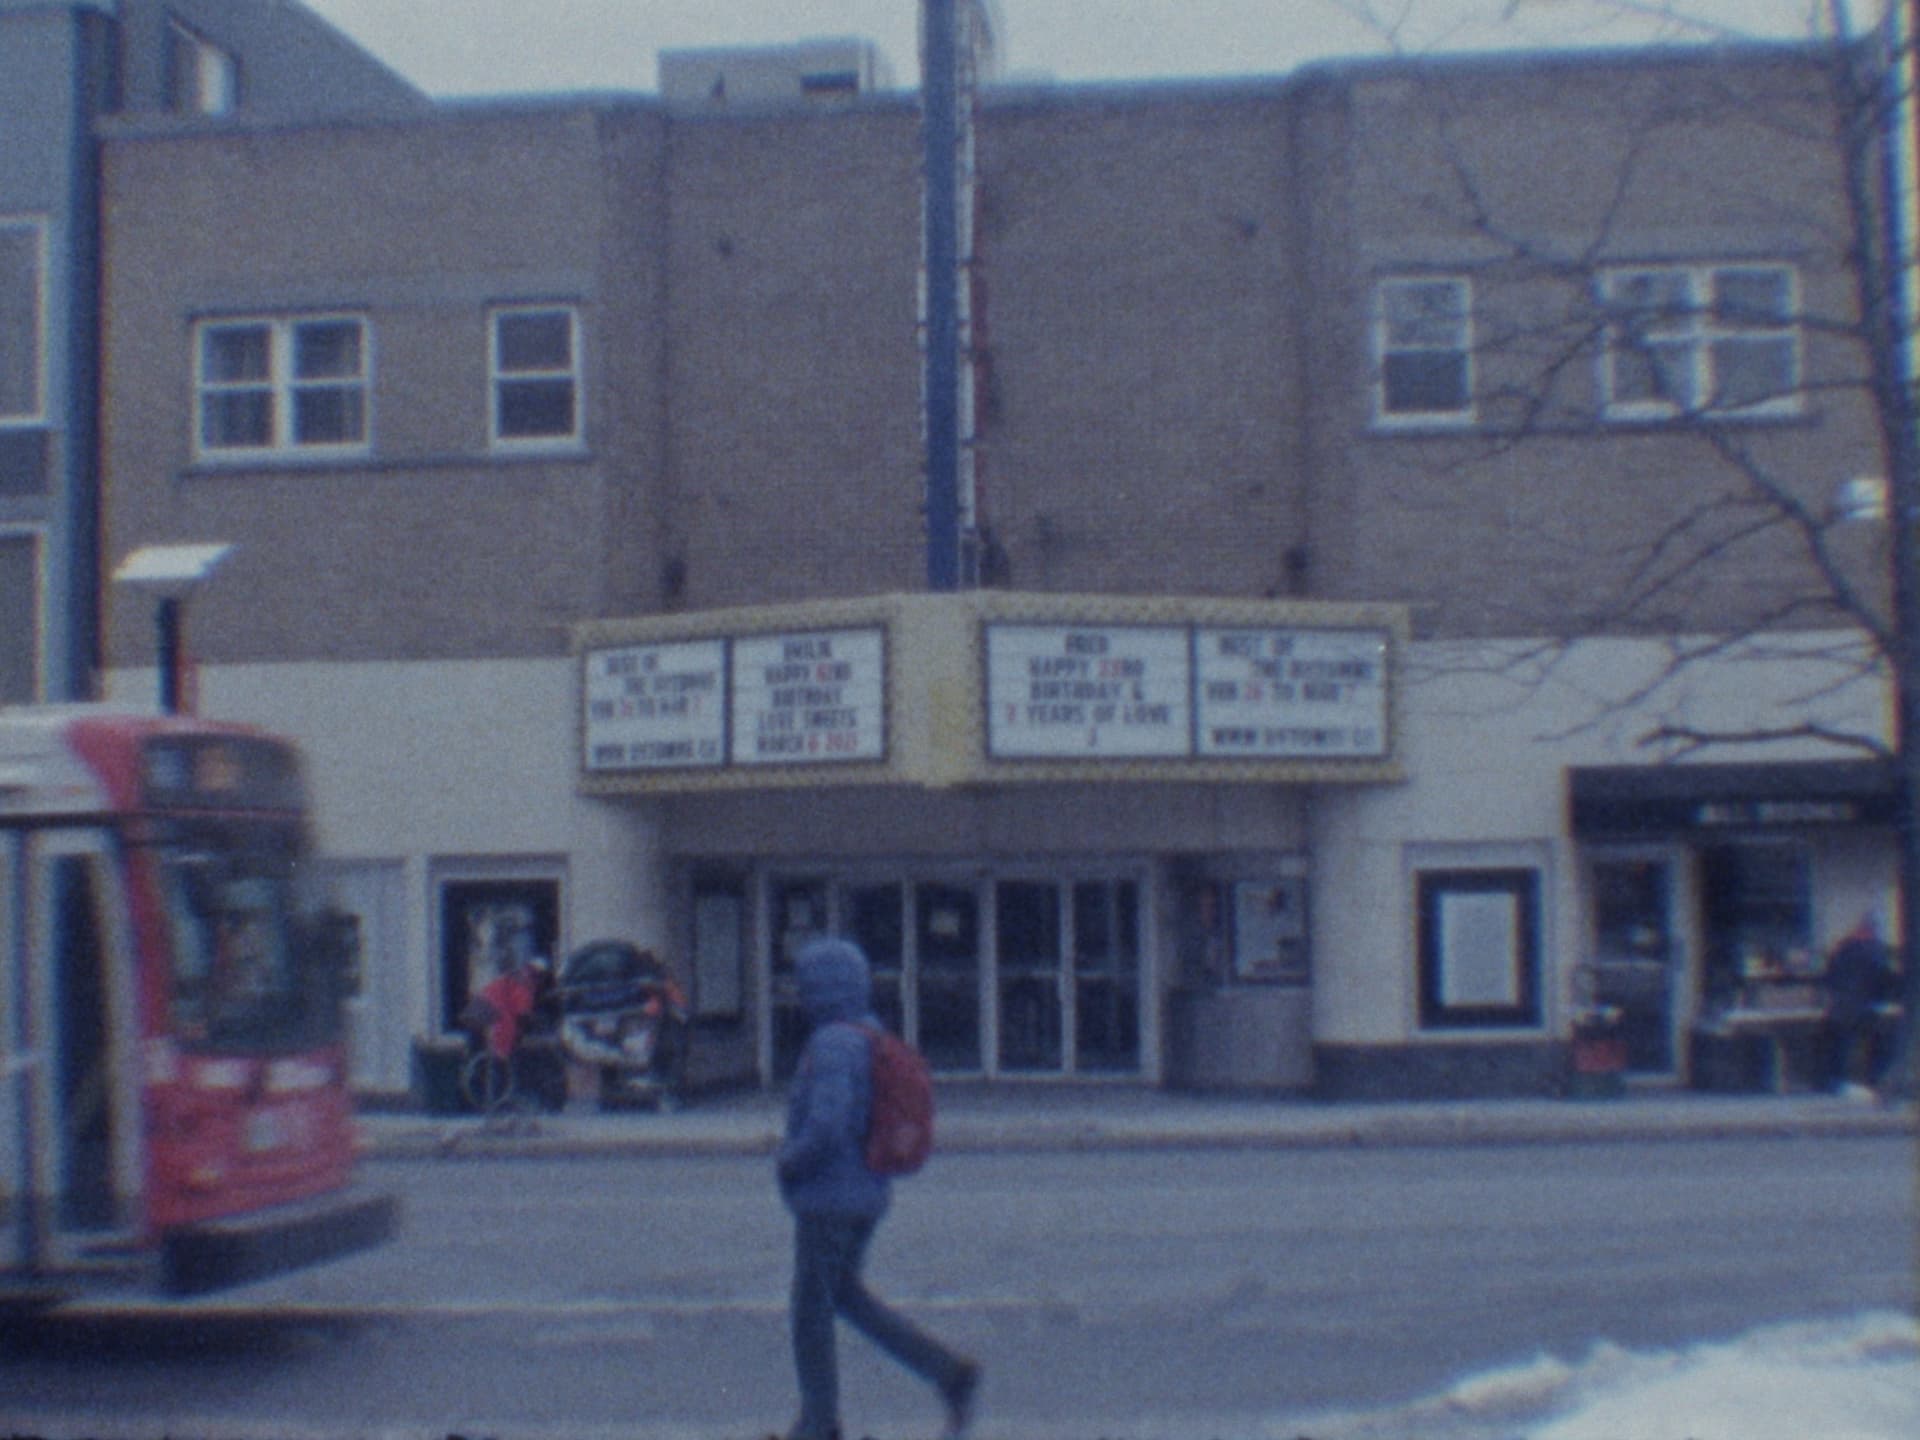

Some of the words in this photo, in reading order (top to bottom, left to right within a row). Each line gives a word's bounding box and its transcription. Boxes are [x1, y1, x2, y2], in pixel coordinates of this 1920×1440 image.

[1030, 657, 1089, 677] HAPPY
[1027, 703, 1085, 724] YEARS
[1094, 703, 1116, 723] OF
[1123, 703, 1171, 724] LOVE
